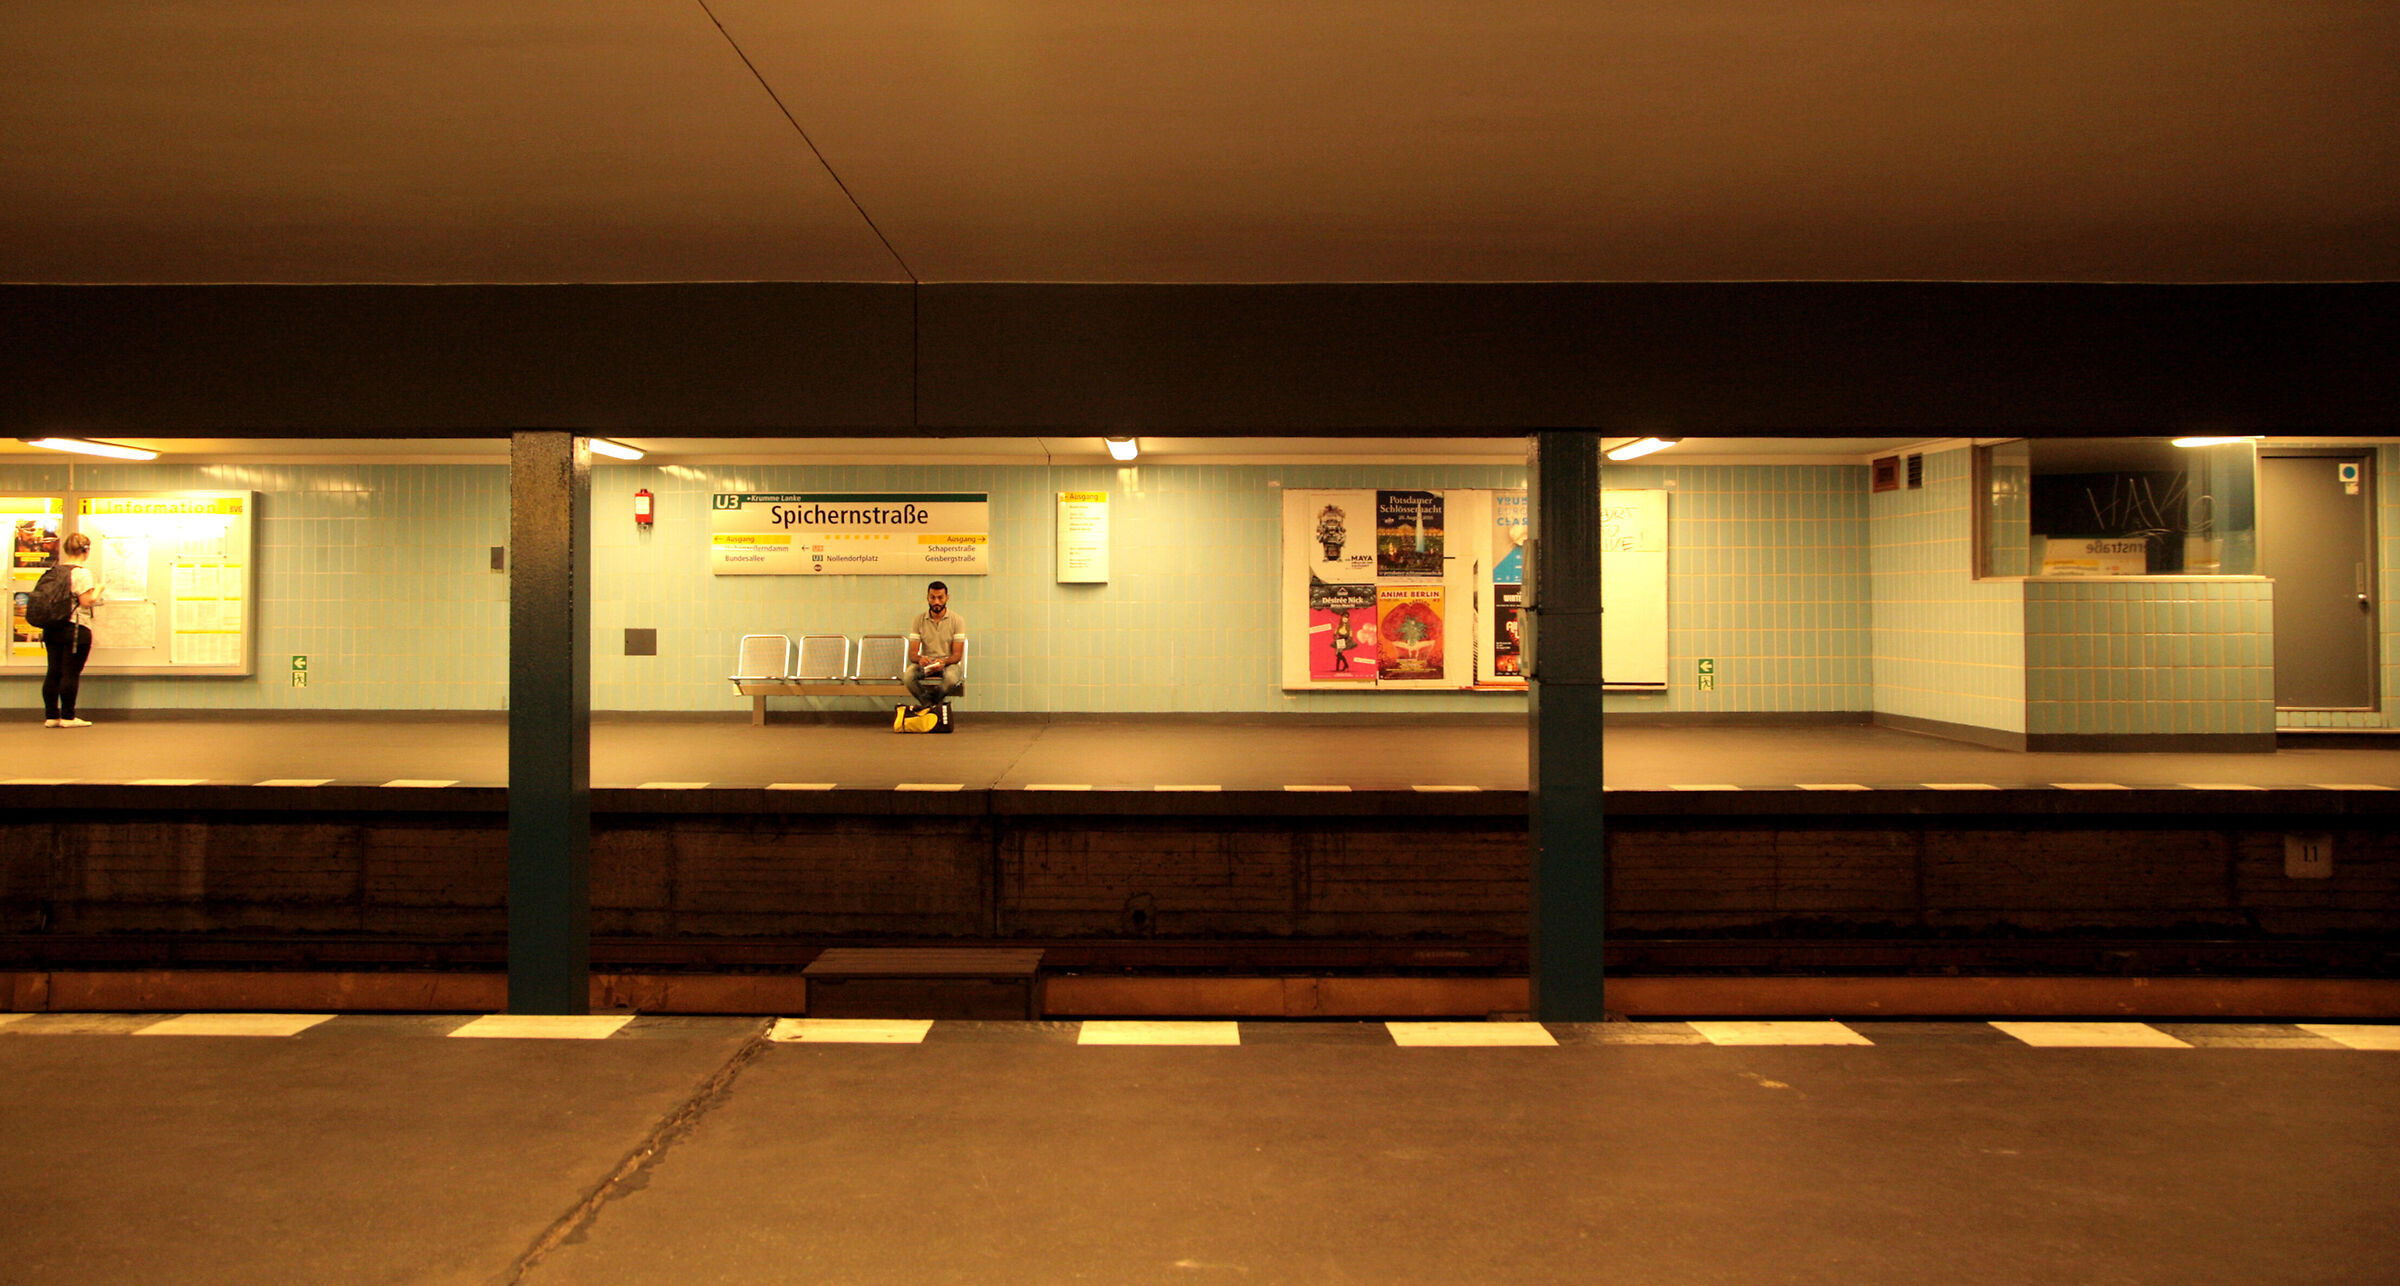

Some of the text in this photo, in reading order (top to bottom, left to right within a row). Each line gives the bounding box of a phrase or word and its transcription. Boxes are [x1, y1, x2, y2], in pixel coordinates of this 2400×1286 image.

[716, 495, 739, 509] U3
[1390, 495, 1433, 504] Potsdamer
[108, 500, 216, 513] Information
[771, 504, 928, 529] Spichernstraße
[947, 535, 976, 543] Ausgang
[928, 545, 975, 553] Schaperstraße
[827, 555, 879, 563] Nollendorfplatz
[925, 555, 975, 563] Geisbergstraße
[1322, 596, 1364, 604] Désirée Nick
